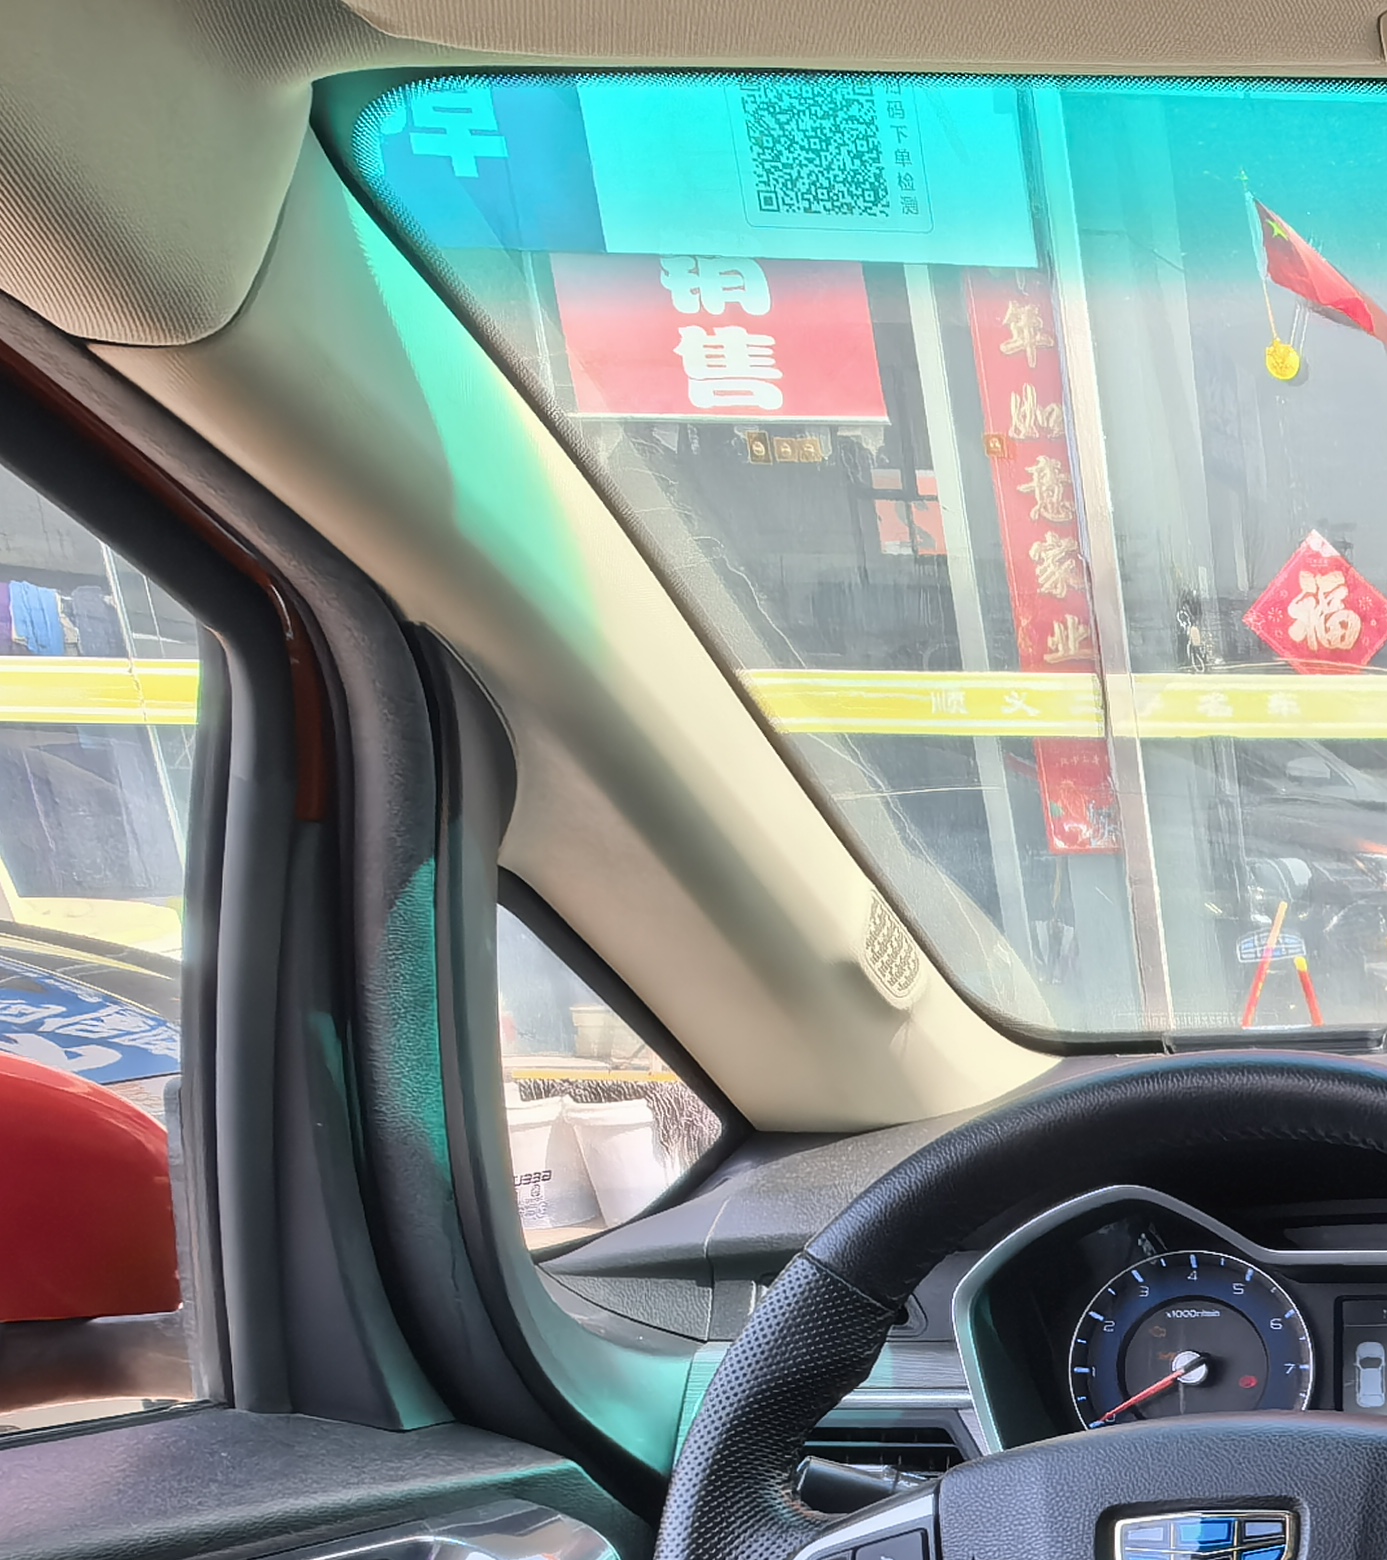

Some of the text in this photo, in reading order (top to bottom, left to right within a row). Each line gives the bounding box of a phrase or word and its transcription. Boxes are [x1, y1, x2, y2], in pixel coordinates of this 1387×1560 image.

[1287, 570, 1362, 653] 福
[1187, 1270, 1198, 1281] 4
[1139, 1286, 1149, 1297] 3
[1233, 1283, 1244, 1295] 5
[1103, 1320, 1115, 1332] 2
[1270, 1318, 1282, 1330] 6
[1284, 1363, 1296, 1375] 7
